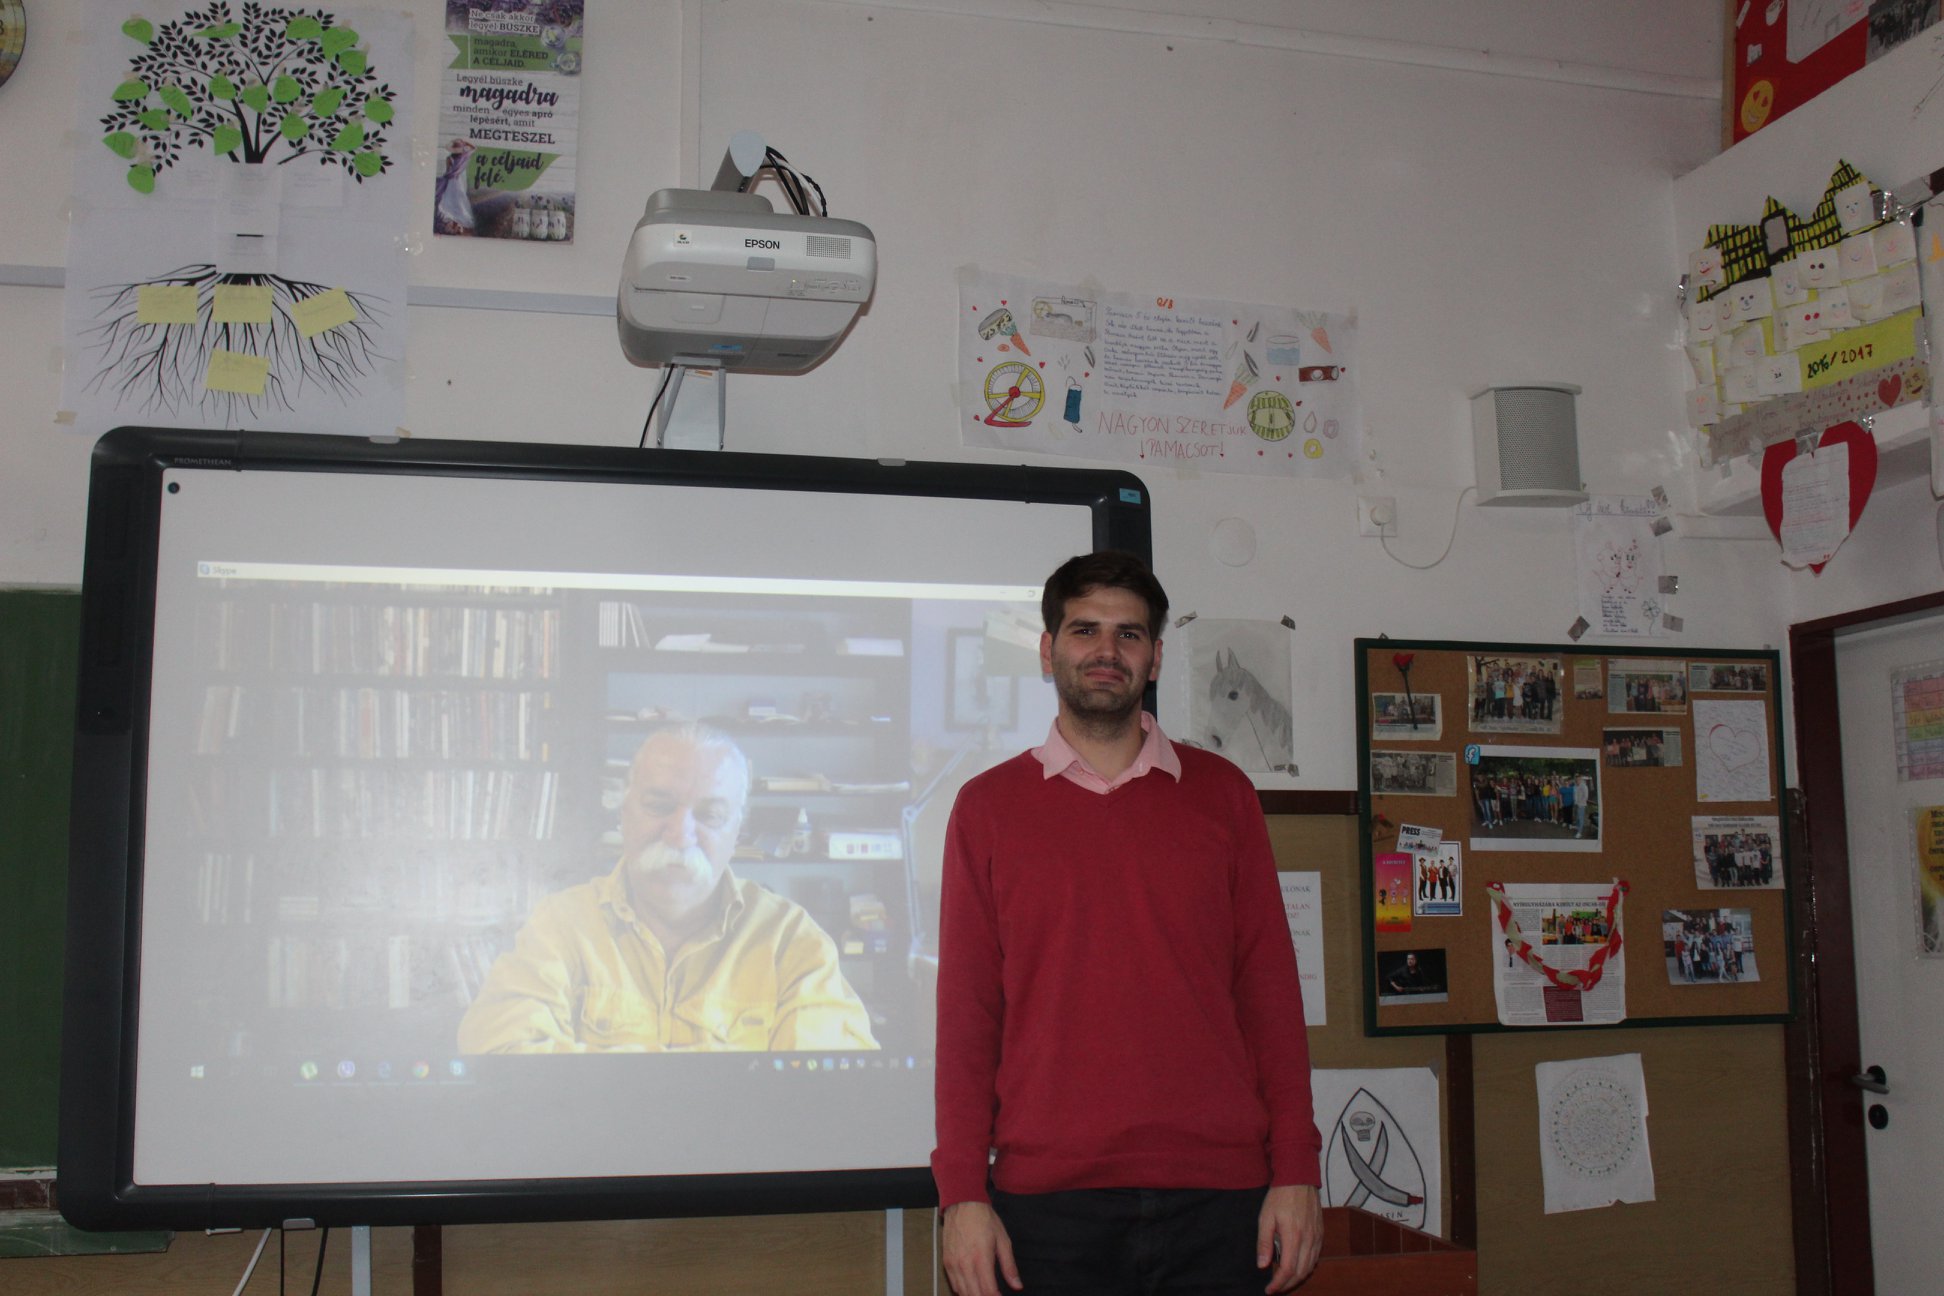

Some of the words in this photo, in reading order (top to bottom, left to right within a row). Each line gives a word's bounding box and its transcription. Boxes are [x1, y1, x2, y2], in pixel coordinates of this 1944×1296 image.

[471, 9, 484, 18] Ne
[485, 10, 506, 20] csak
[508, 12, 535, 22] akkor
[470, 21, 497, 31] legyél
[499, 22, 539, 33] BÜSZKE
[473, 48, 507, 57] amikor
[510, 49, 549, 60] ELÉRED
[456, 74, 487, 84] Legyél
[490, 77, 523, 87] büszke
[460, 83, 559, 110] magadra
[453, 104, 490, 114] minden
[502, 108, 530, 117] egyes
[532, 109, 553, 119] apró
[513, 119, 535, 127] amit
[470, 128, 556, 145] MEGTESZEL
[476, 154, 488, 166] a
[491, 151, 544, 174] céljaid
[744, 238, 780, 250] EPSON
[1097, 411, 1169, 436] NAGYON
[174, 457, 232, 466] PROMETHEAN
[212, 566, 237, 576] Skype
[1401, 825, 1421, 836] PRESS
